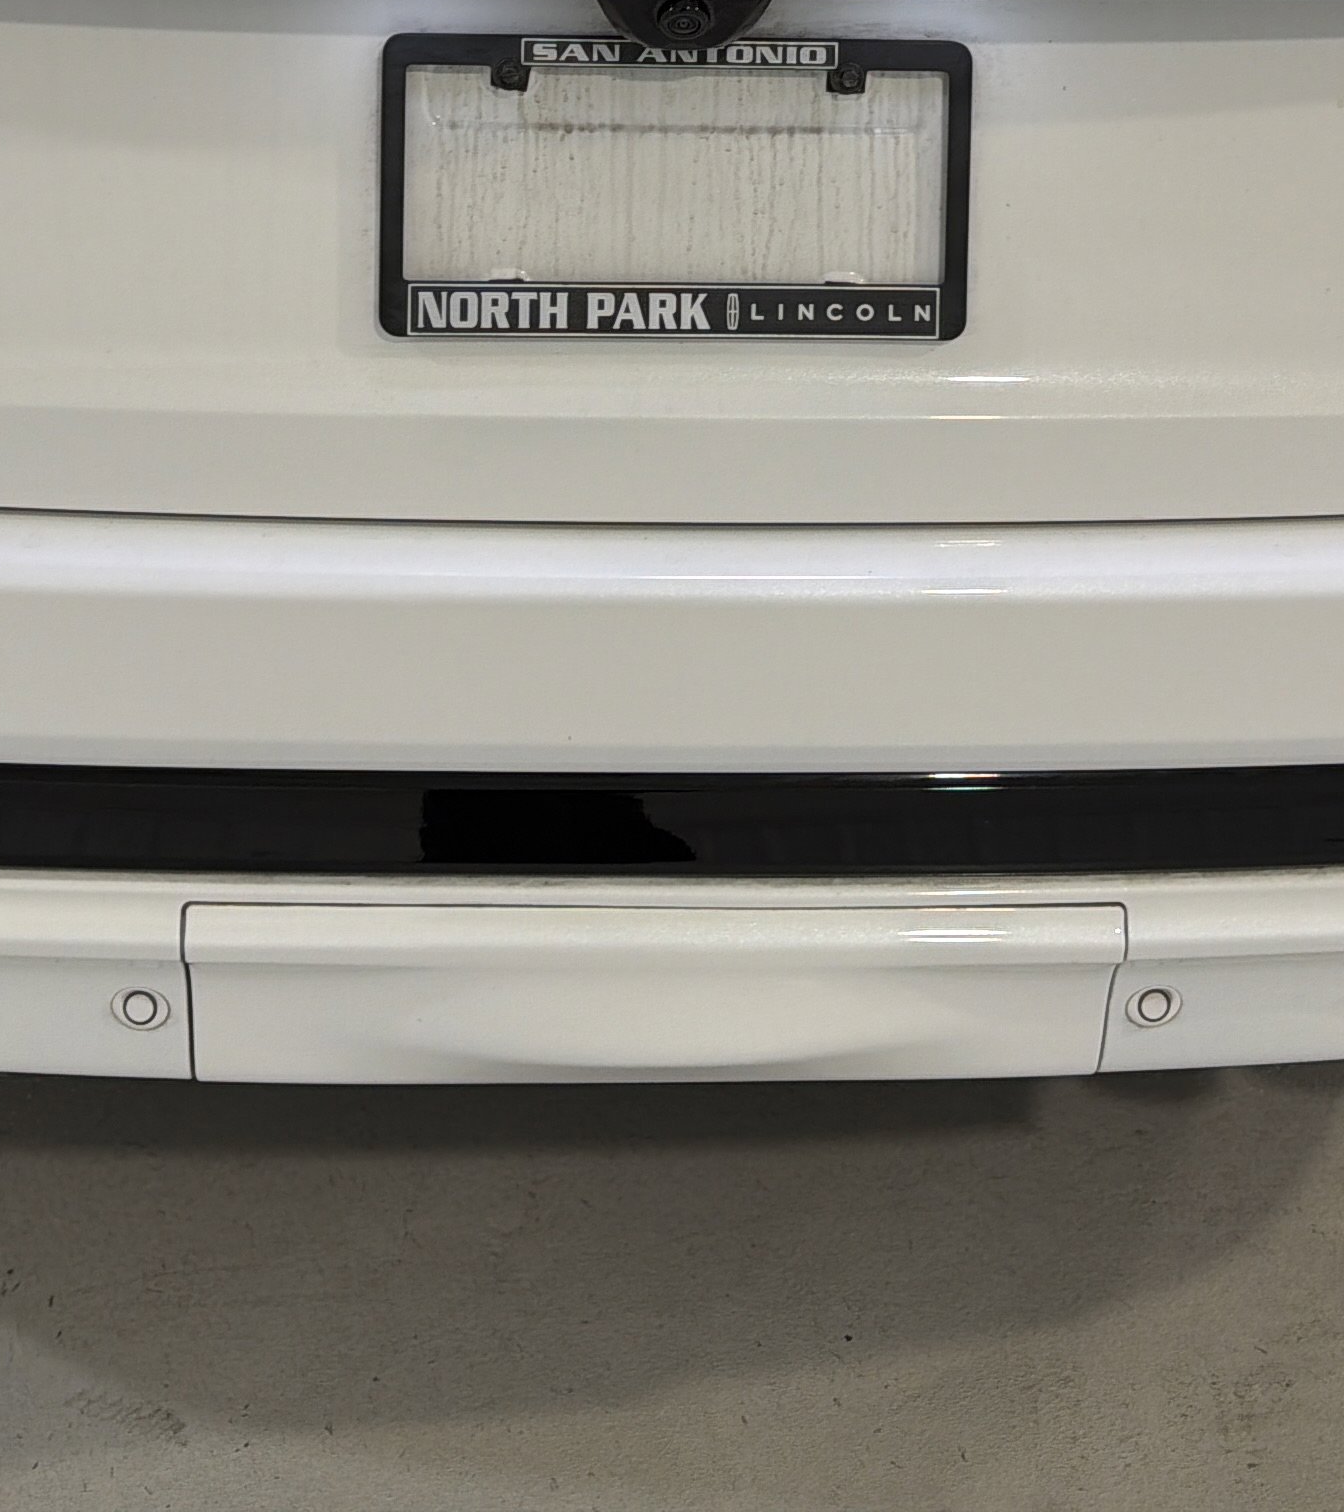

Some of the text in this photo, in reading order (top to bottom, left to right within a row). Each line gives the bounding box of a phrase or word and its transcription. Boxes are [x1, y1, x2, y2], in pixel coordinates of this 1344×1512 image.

[533, 43, 620, 62] SAN
[417, 291, 932, 331] NORTH PARK LINCOLN
